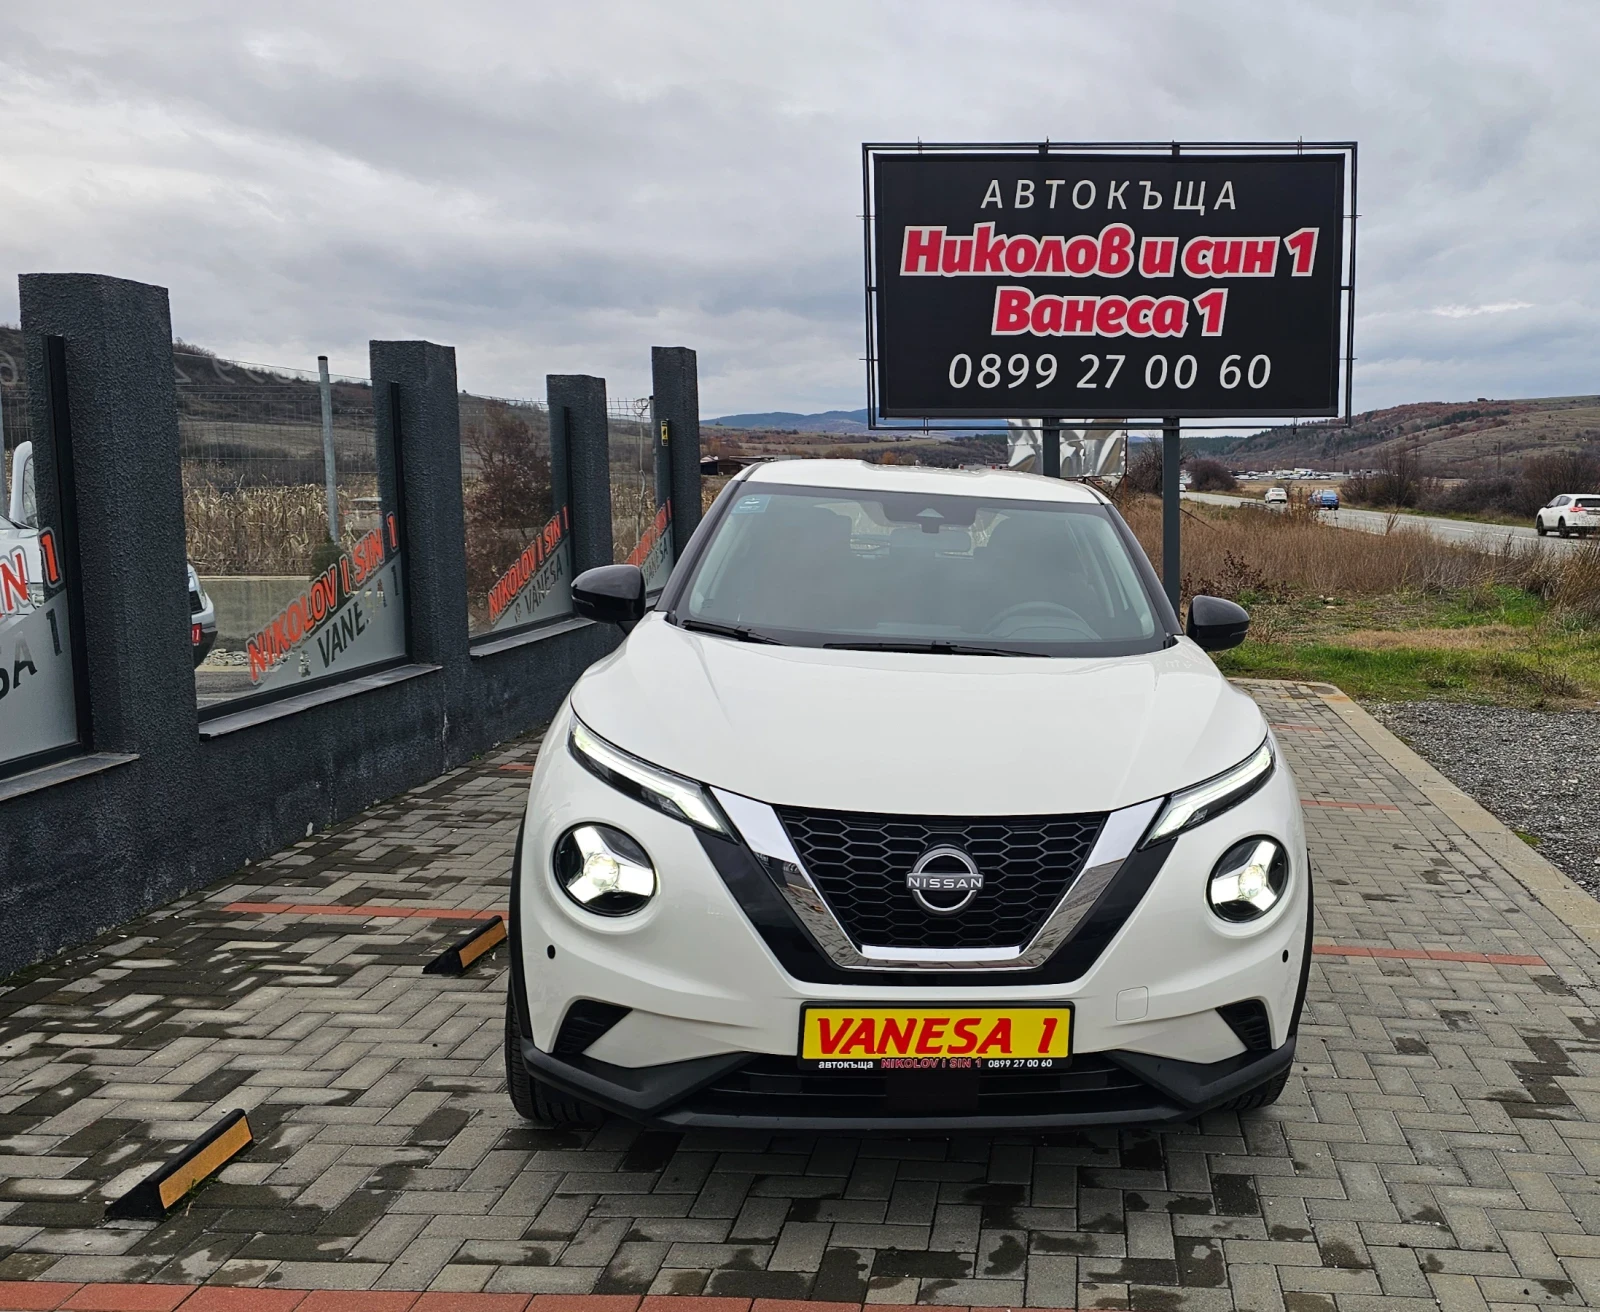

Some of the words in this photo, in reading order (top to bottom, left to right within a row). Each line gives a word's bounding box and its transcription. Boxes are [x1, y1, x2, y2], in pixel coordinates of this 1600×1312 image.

[980, 179, 1236, 216] АВТОКЪЩА
[900, 221, 1135, 278] Николов
[1138, 237, 1179, 278] и
[1181, 236, 1280, 278] син
[1283, 228, 1320, 277] 1
[991, 286, 1189, 338] Ванеса
[1193, 288, 1229, 336] 1
[948, 353, 1058, 389] 0899
[1076, 354, 1126, 389] 27
[1144, 354, 1198, 389] 00
[1219, 354, 1271, 389] 60
[37, 526, 64, 589] 1
[390, 563, 399, 596] 1
[488, 540, 537, 625] NIKOLOV
[536, 533, 545, 565] I
[544, 511, 561, 557] SIN
[562, 503, 569, 531] 1
[524, 558, 563, 615] VANESA
[563, 544, 570, 567] 1
[246, 562, 337, 685] NIKOLOV
[339, 553, 351, 598] I
[352, 527, 385, 586] SIN
[386, 511, 399, 552] 1
[46, 607, 62, 657] 1
[908, 876, 983, 889] NISSAN
[817, 1018, 1012, 1055] VANESA
[1038, 1018, 1058, 1054] 1
[818, 1060, 874, 1069] автокъща
[881, 1057, 939, 1069] NIKOLOV
[949, 1057, 971, 1068] SIN
[975, 1057, 982, 1068] 1
[988, 1059, 1011, 1068] 0899
[1013, 1059, 1025, 1068] 27
[1027, 1059, 1039, 1068] 00
[1041, 1058, 1052, 1068] 60
